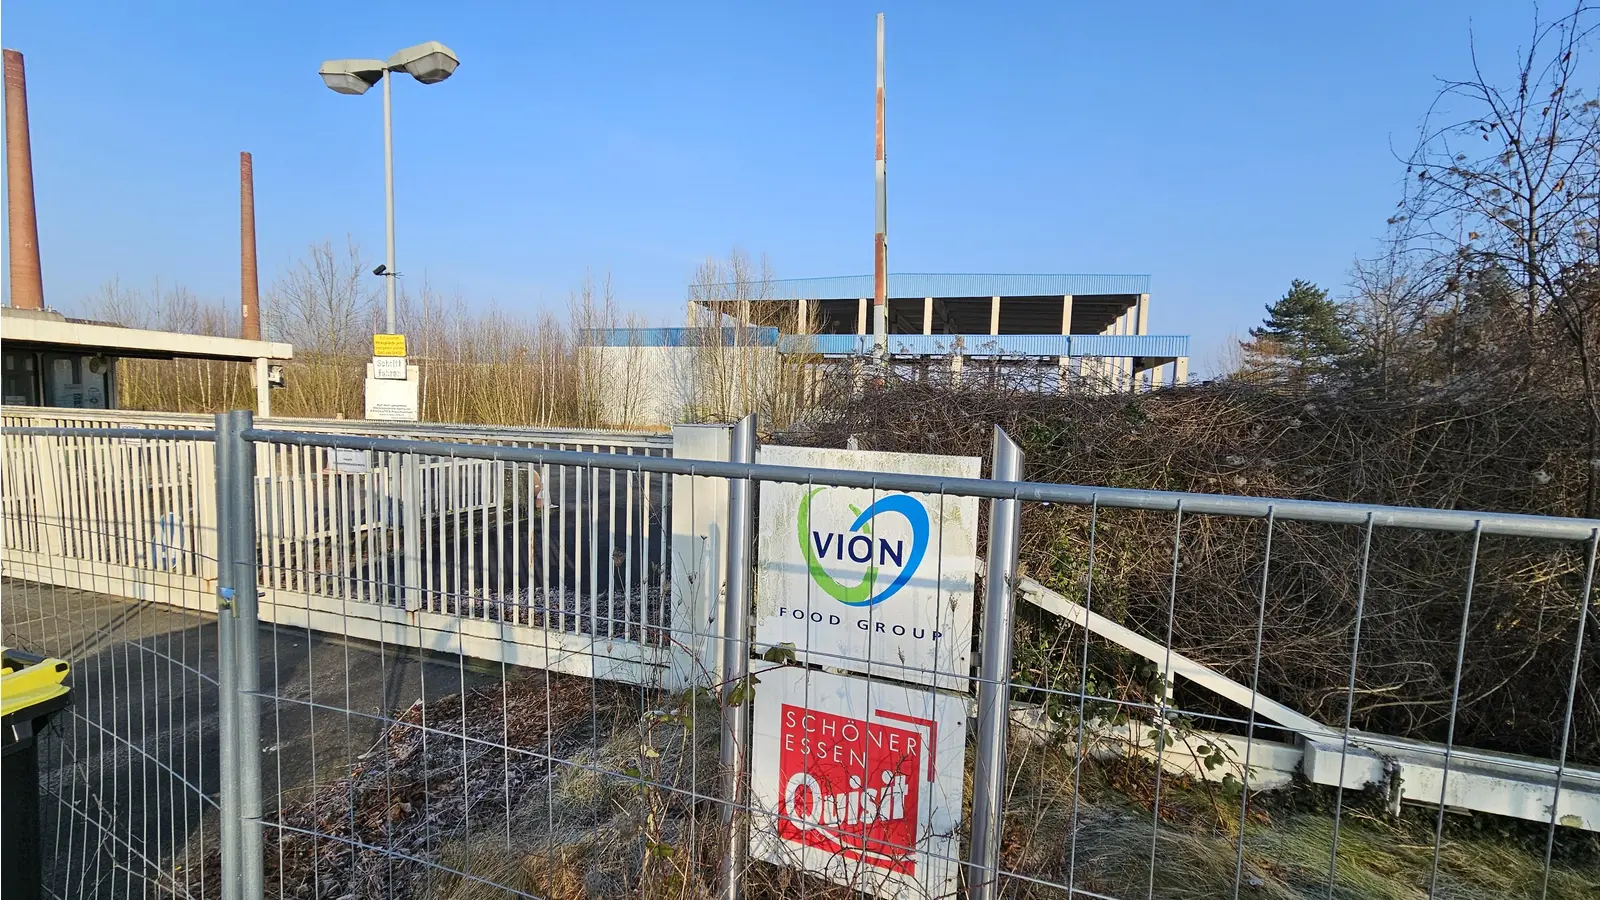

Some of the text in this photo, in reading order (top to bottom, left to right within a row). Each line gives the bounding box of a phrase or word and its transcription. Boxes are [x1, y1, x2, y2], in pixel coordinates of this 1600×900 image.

[813, 531, 903, 567] VION
[779, 607, 943, 641] FOOD GROUP
[785, 734, 867, 769] ESSEN
[786, 711, 917, 756] SCHÖNER
[785, 769, 915, 862] Quisit
